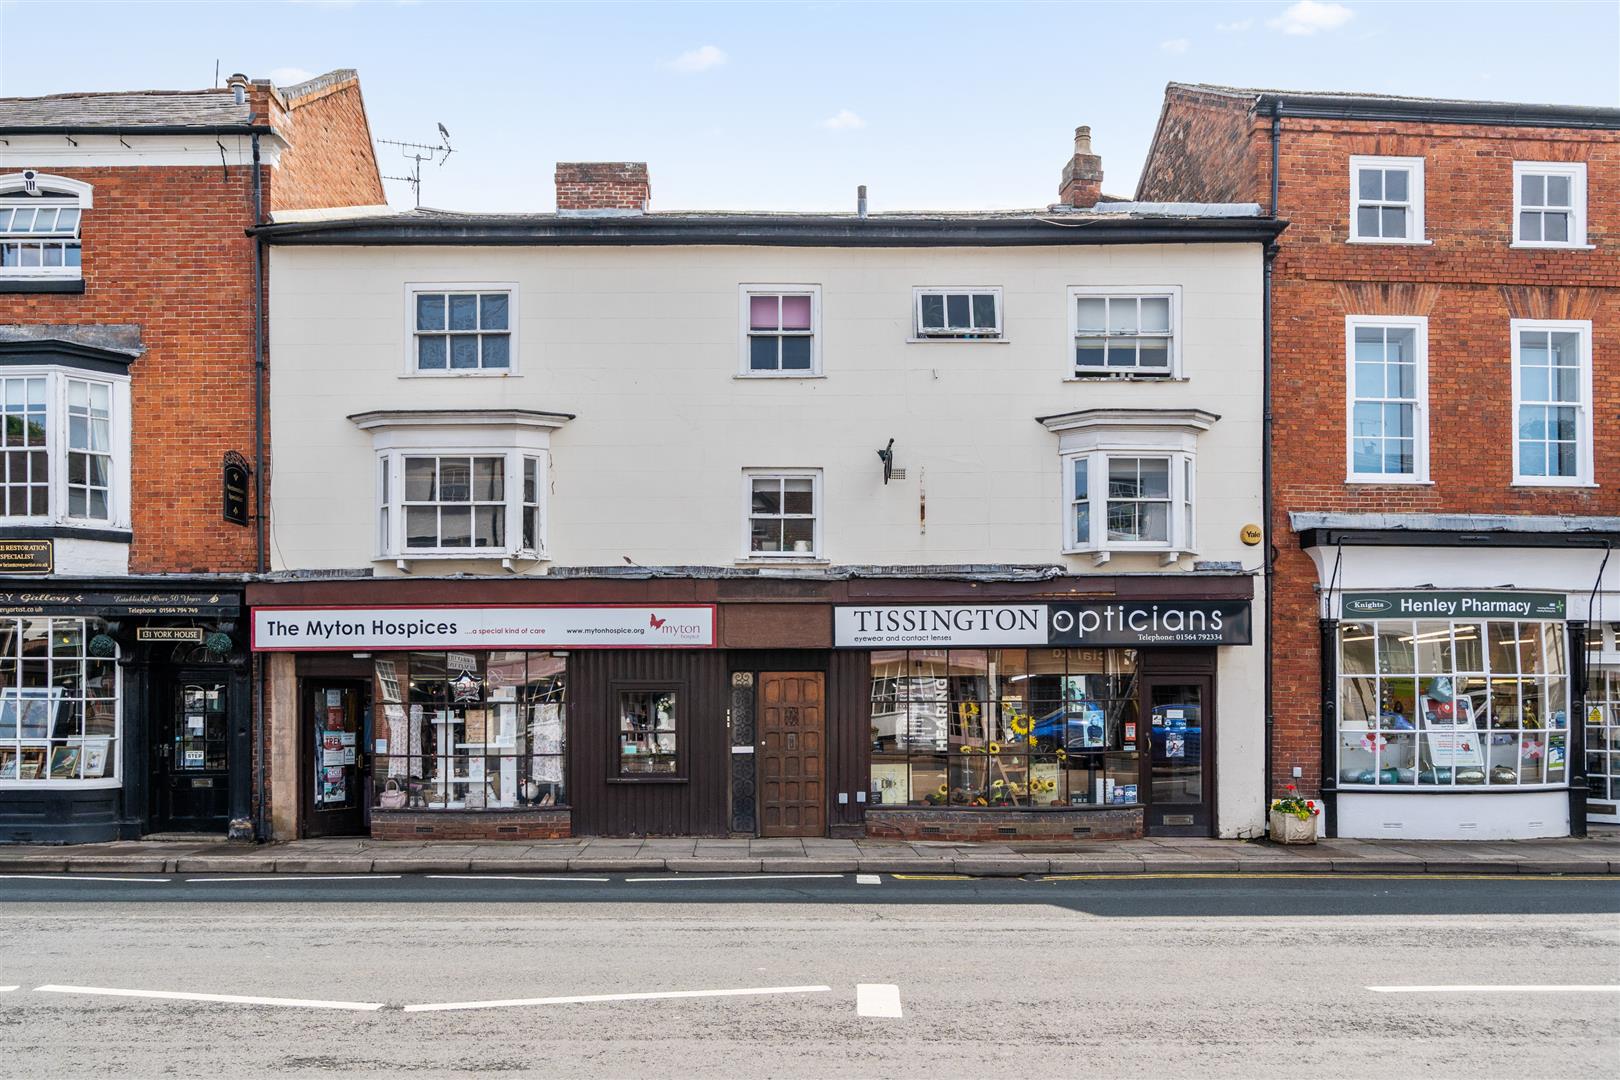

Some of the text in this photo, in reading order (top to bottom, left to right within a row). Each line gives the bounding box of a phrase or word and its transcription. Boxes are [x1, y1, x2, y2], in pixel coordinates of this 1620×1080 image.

[20, 593, 70, 603] Gallery
[113, 594, 151, 604] Established
[1354, 601, 1384, 609] Knights
[1400, 598, 1456, 614] Henley
[1461, 598, 1531, 615] Pharmacy
[853, 609, 1040, 632] TISSINGTON
[1052, 605, 1223, 638] opticians
[267, 619, 457, 638] The Myton Hospices
[478, 627, 504, 636] special
[504, 627, 519, 635] kind
[520, 627, 528, 635] of
[566, 627, 645, 636] www.mytonhospice.org
[661, 624, 701, 637] myton
[1138, 633, 1175, 641] Telephone:
[935, 678, 948, 752] HEARING
